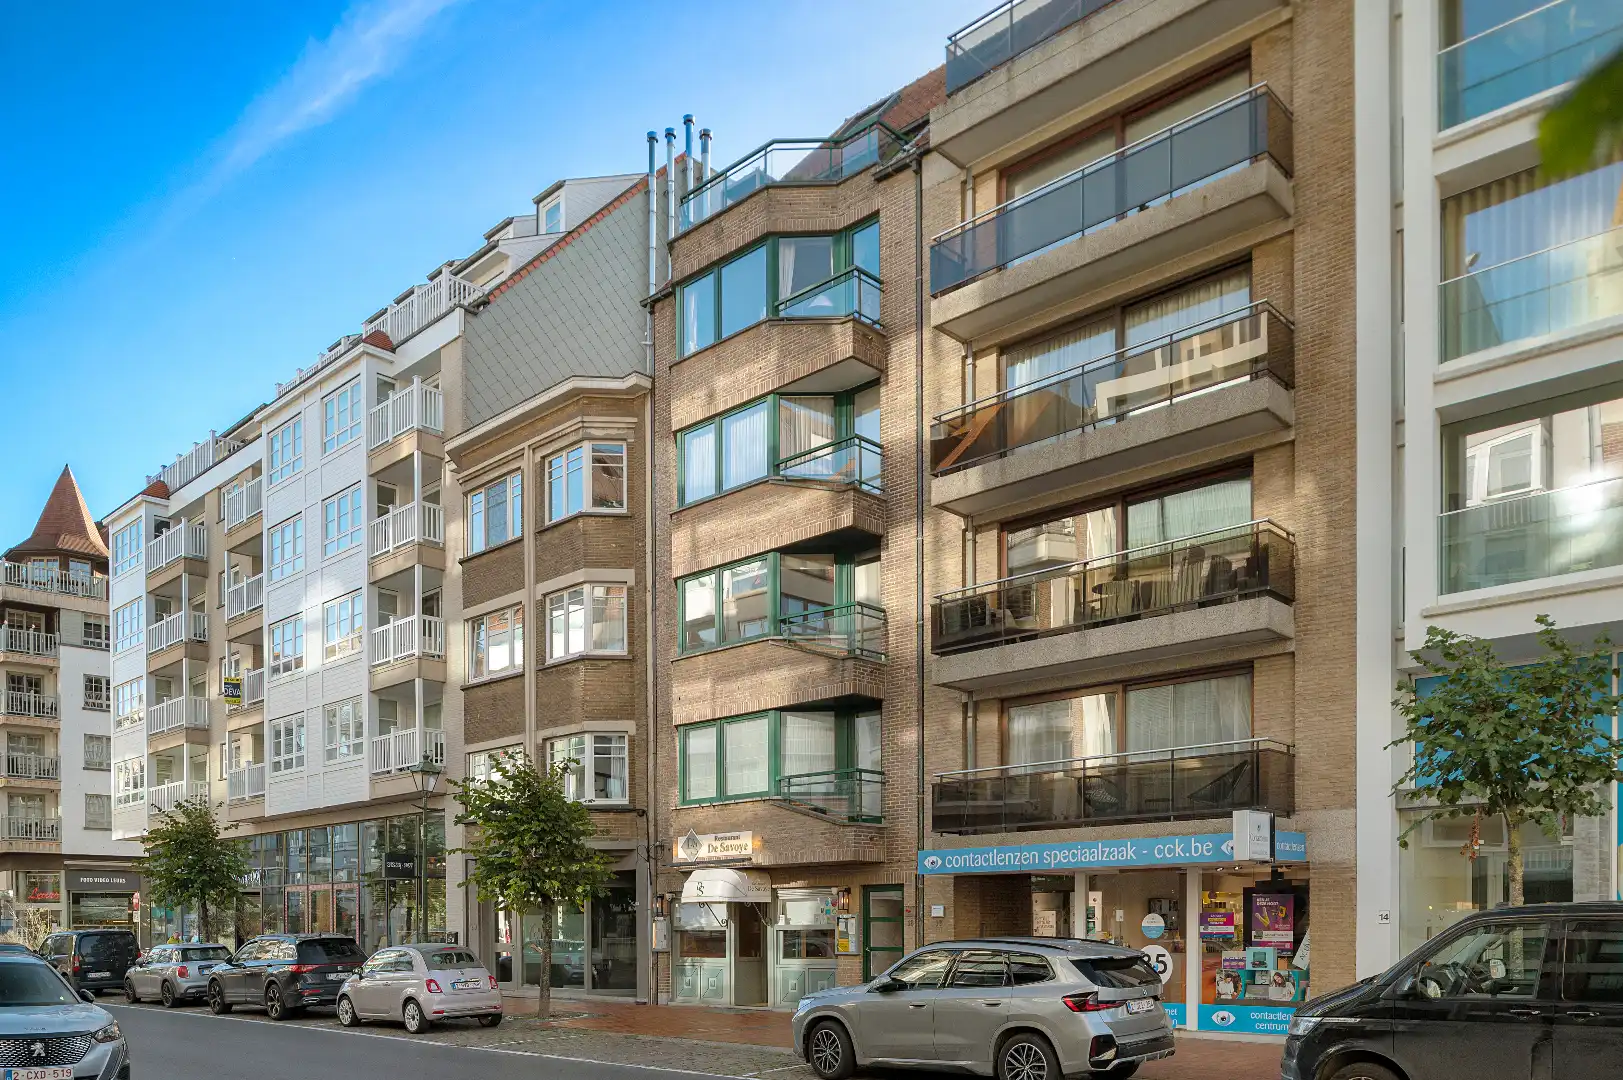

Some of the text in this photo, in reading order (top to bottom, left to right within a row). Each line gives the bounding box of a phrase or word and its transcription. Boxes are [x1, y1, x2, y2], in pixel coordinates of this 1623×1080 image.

[714, 834, 741, 842] Restaurant
[707, 841, 749, 854] De Savoye
[945, 848, 1039, 868] contactlenzen
[1043, 841, 1137, 868] speciaalzaak
[1154, 838, 1213, 859] cck.be
[1378, 913, 1390, 921] 14
[1250, 1011, 1293, 1021] contactlen
[13, 1068, 72, 1080] 2-CXD-519
